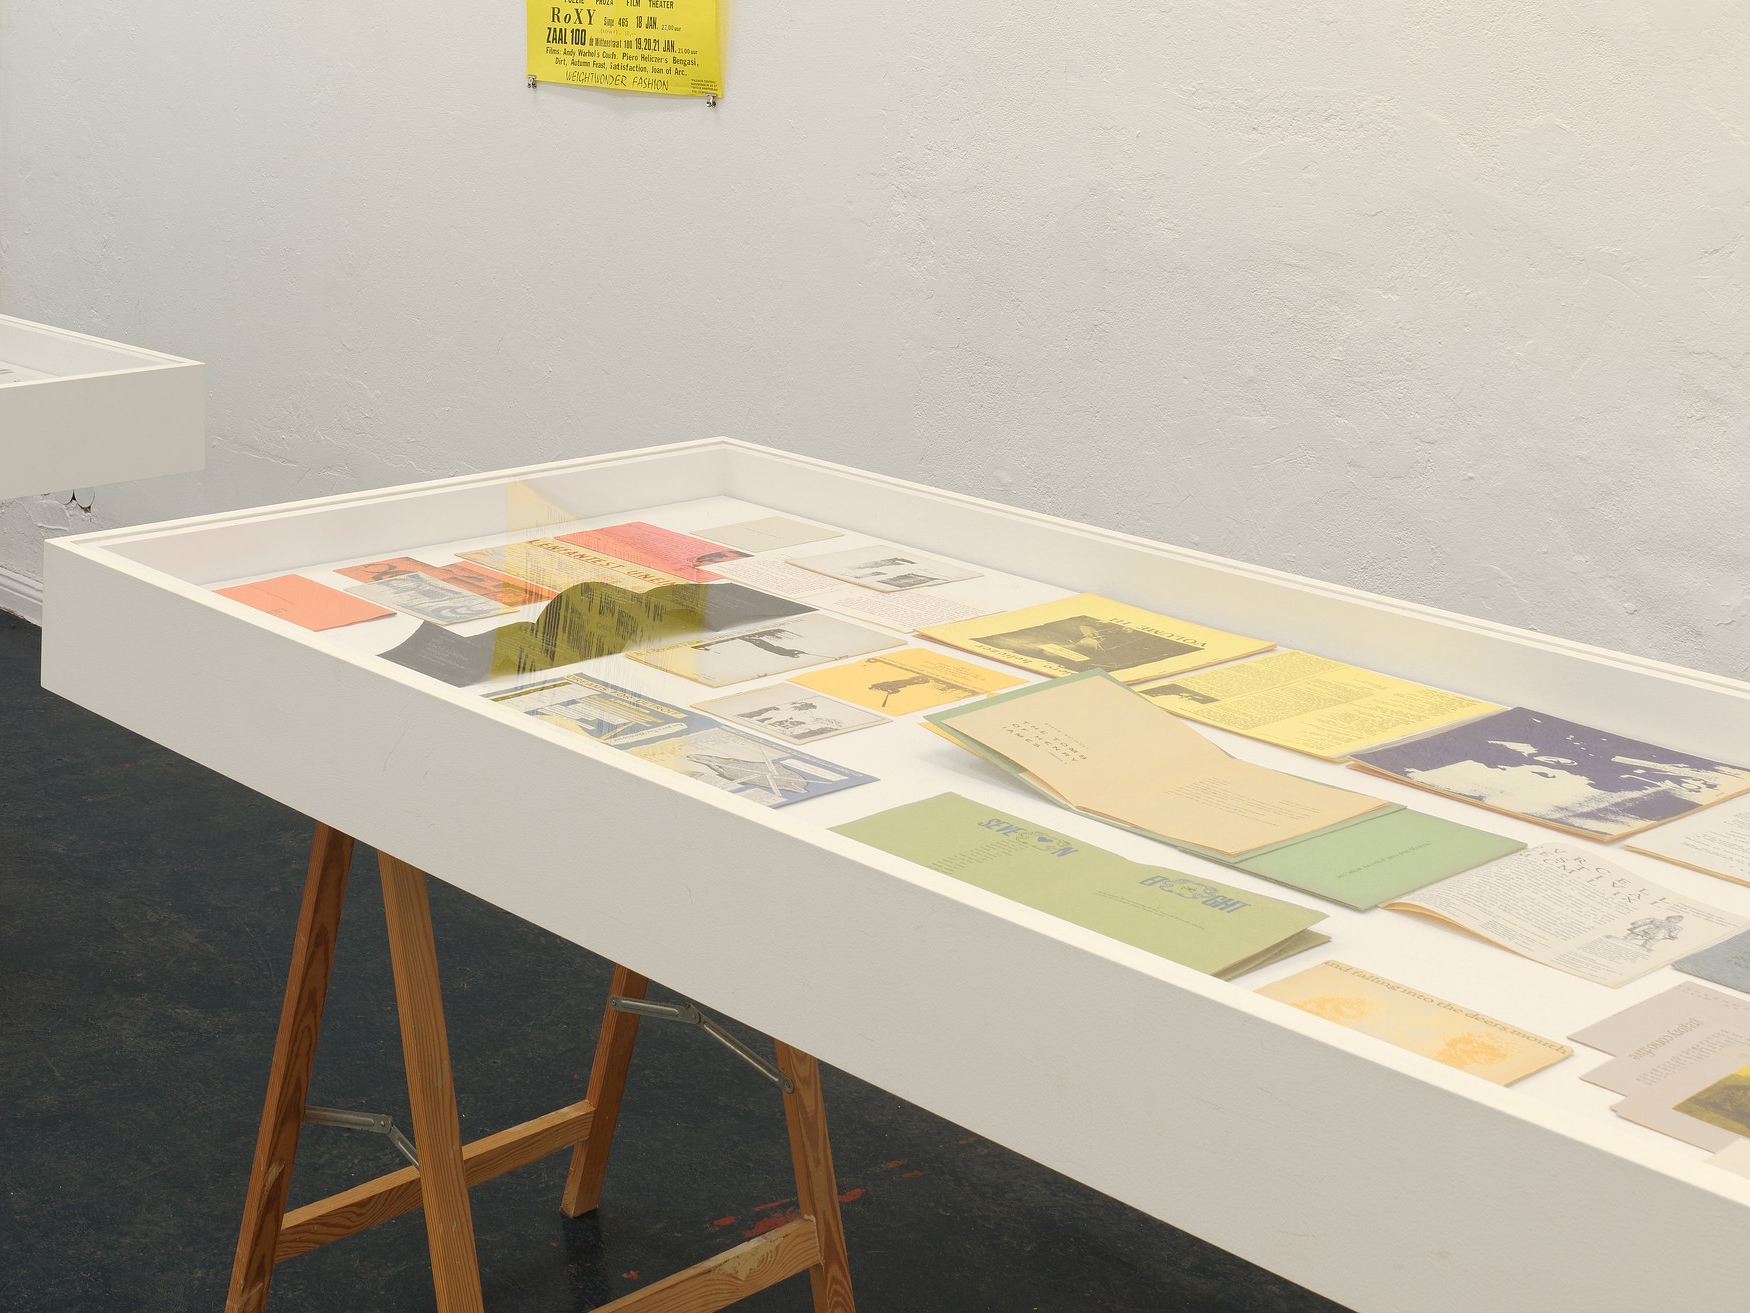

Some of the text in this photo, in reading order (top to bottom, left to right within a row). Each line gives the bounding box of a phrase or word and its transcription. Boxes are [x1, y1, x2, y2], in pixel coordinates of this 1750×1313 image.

[649, 0, 674, 9] THEATER
[617, 17, 629, 27] 465
[636, 15, 643, 29] 18
[645, 17, 659, 30] JAN.
[546, 27, 568, 44] ZAAL
[570, 28, 587, 46] 100
[662, 40, 677, 54] JAN.
[546, 47, 561, 56] Films:
[563, 48, 577, 58] Andy
[622, 52, 639, 61] Piero
[555, 57, 687, 77] Dirt, Autumn Feast, Satisfaction, Joan of Arc.
[565, 70, 669, 91] WEIGHTWONDER FASHION
[1141, 624, 1209, 648] VOLUME
[1012, 723, 1030, 733] OF
[1035, 734, 1079, 762] HENRY
[1023, 720, 1049, 736] THE
[1053, 736, 1088, 760] TOMB
[1351, 968, 1400, 992] falling
[1401, 987, 1434, 1004] into
[1437, 1000, 1466, 1015] the
[1465, 1010, 1510, 1032] deers
[1511, 1027, 1569, 1055] mouth
